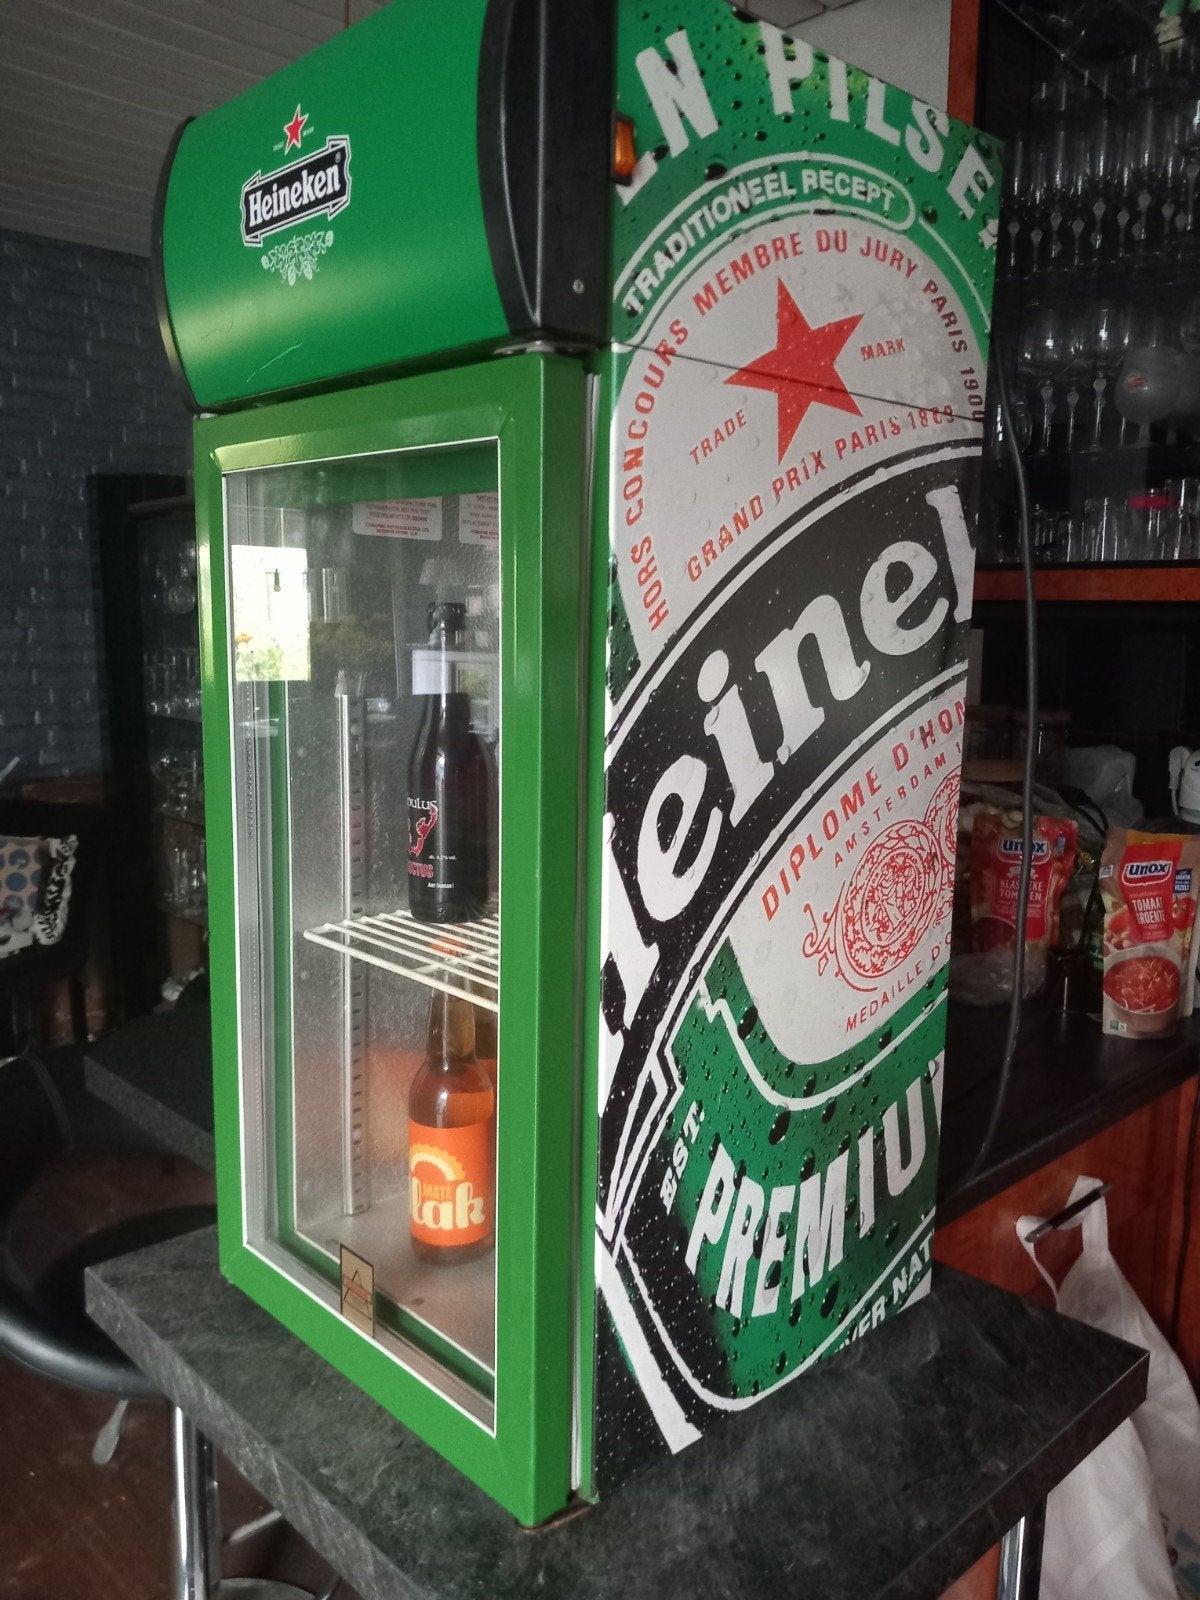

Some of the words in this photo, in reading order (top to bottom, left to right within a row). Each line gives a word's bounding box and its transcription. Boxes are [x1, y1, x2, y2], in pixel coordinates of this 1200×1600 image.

[759, 20, 998, 250] PILSE
[249, 164, 340, 227] Heineken
[622, 170, 797, 315] TRADITIONEEL
[802, 168, 896, 211] RECEPT
[816, 229, 848, 253] DU
[692, 230, 804, 317] MEMBRE
[860, 236, 919, 280] JURY
[922, 279, 968, 354] PARIS
[623, 319, 689, 526] CONCOURS
[689, 409, 748, 466] TRADE
[860, 338, 906, 362] MARK
[688, 495, 765, 583] GRAND
[772, 451, 826, 504] PRIX
[834, 415, 901, 461] PARIS
[631, 535, 669, 631] HORS
[761, 766, 882, 921] DIPLOME
[834, 751, 947, 868] AMSTERDAM
[1003, 840, 1045, 853] unx
[845, 959, 922, 1033] MEDAILLE
[684, 1049, 945, 1319] PREMIU
